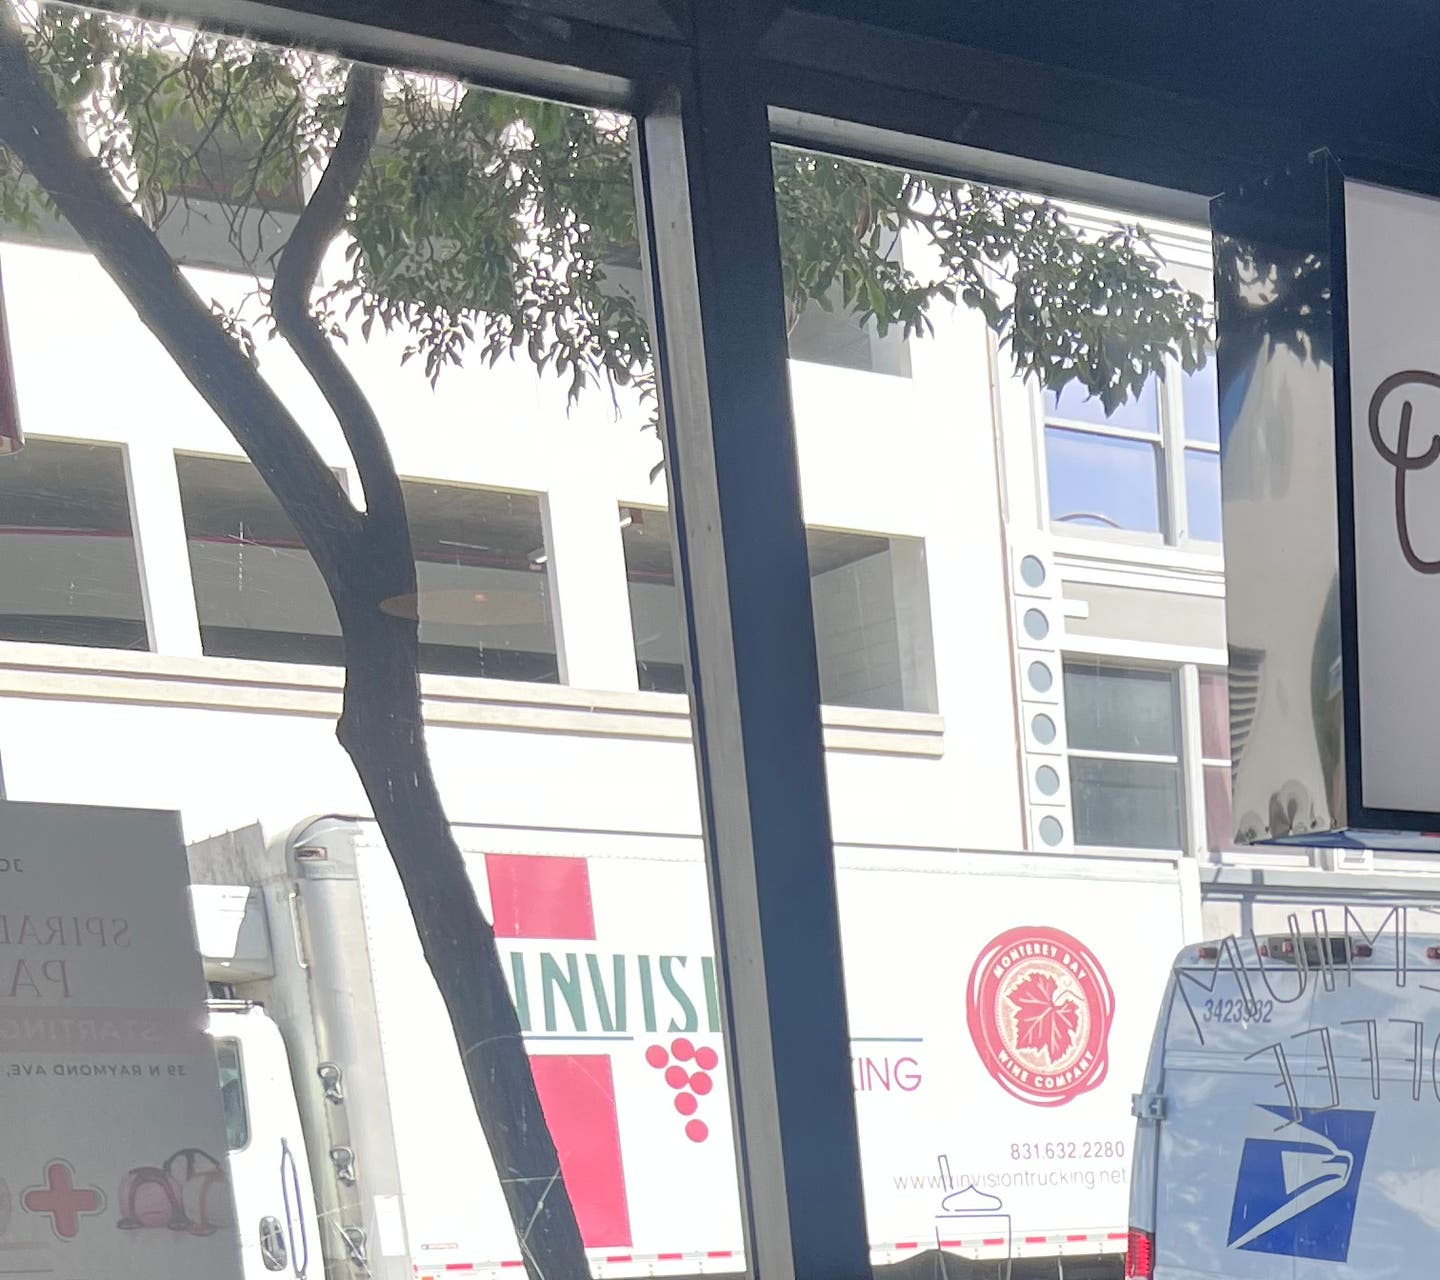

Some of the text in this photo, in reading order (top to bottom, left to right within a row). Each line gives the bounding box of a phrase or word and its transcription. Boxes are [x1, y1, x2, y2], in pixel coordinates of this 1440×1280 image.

[992, 943, 1088, 980] MONTEREY BAY
[998, 1050, 1095, 1089] WINE COMPANY
[1010, 1140, 1125, 1161] 831.632.2280
